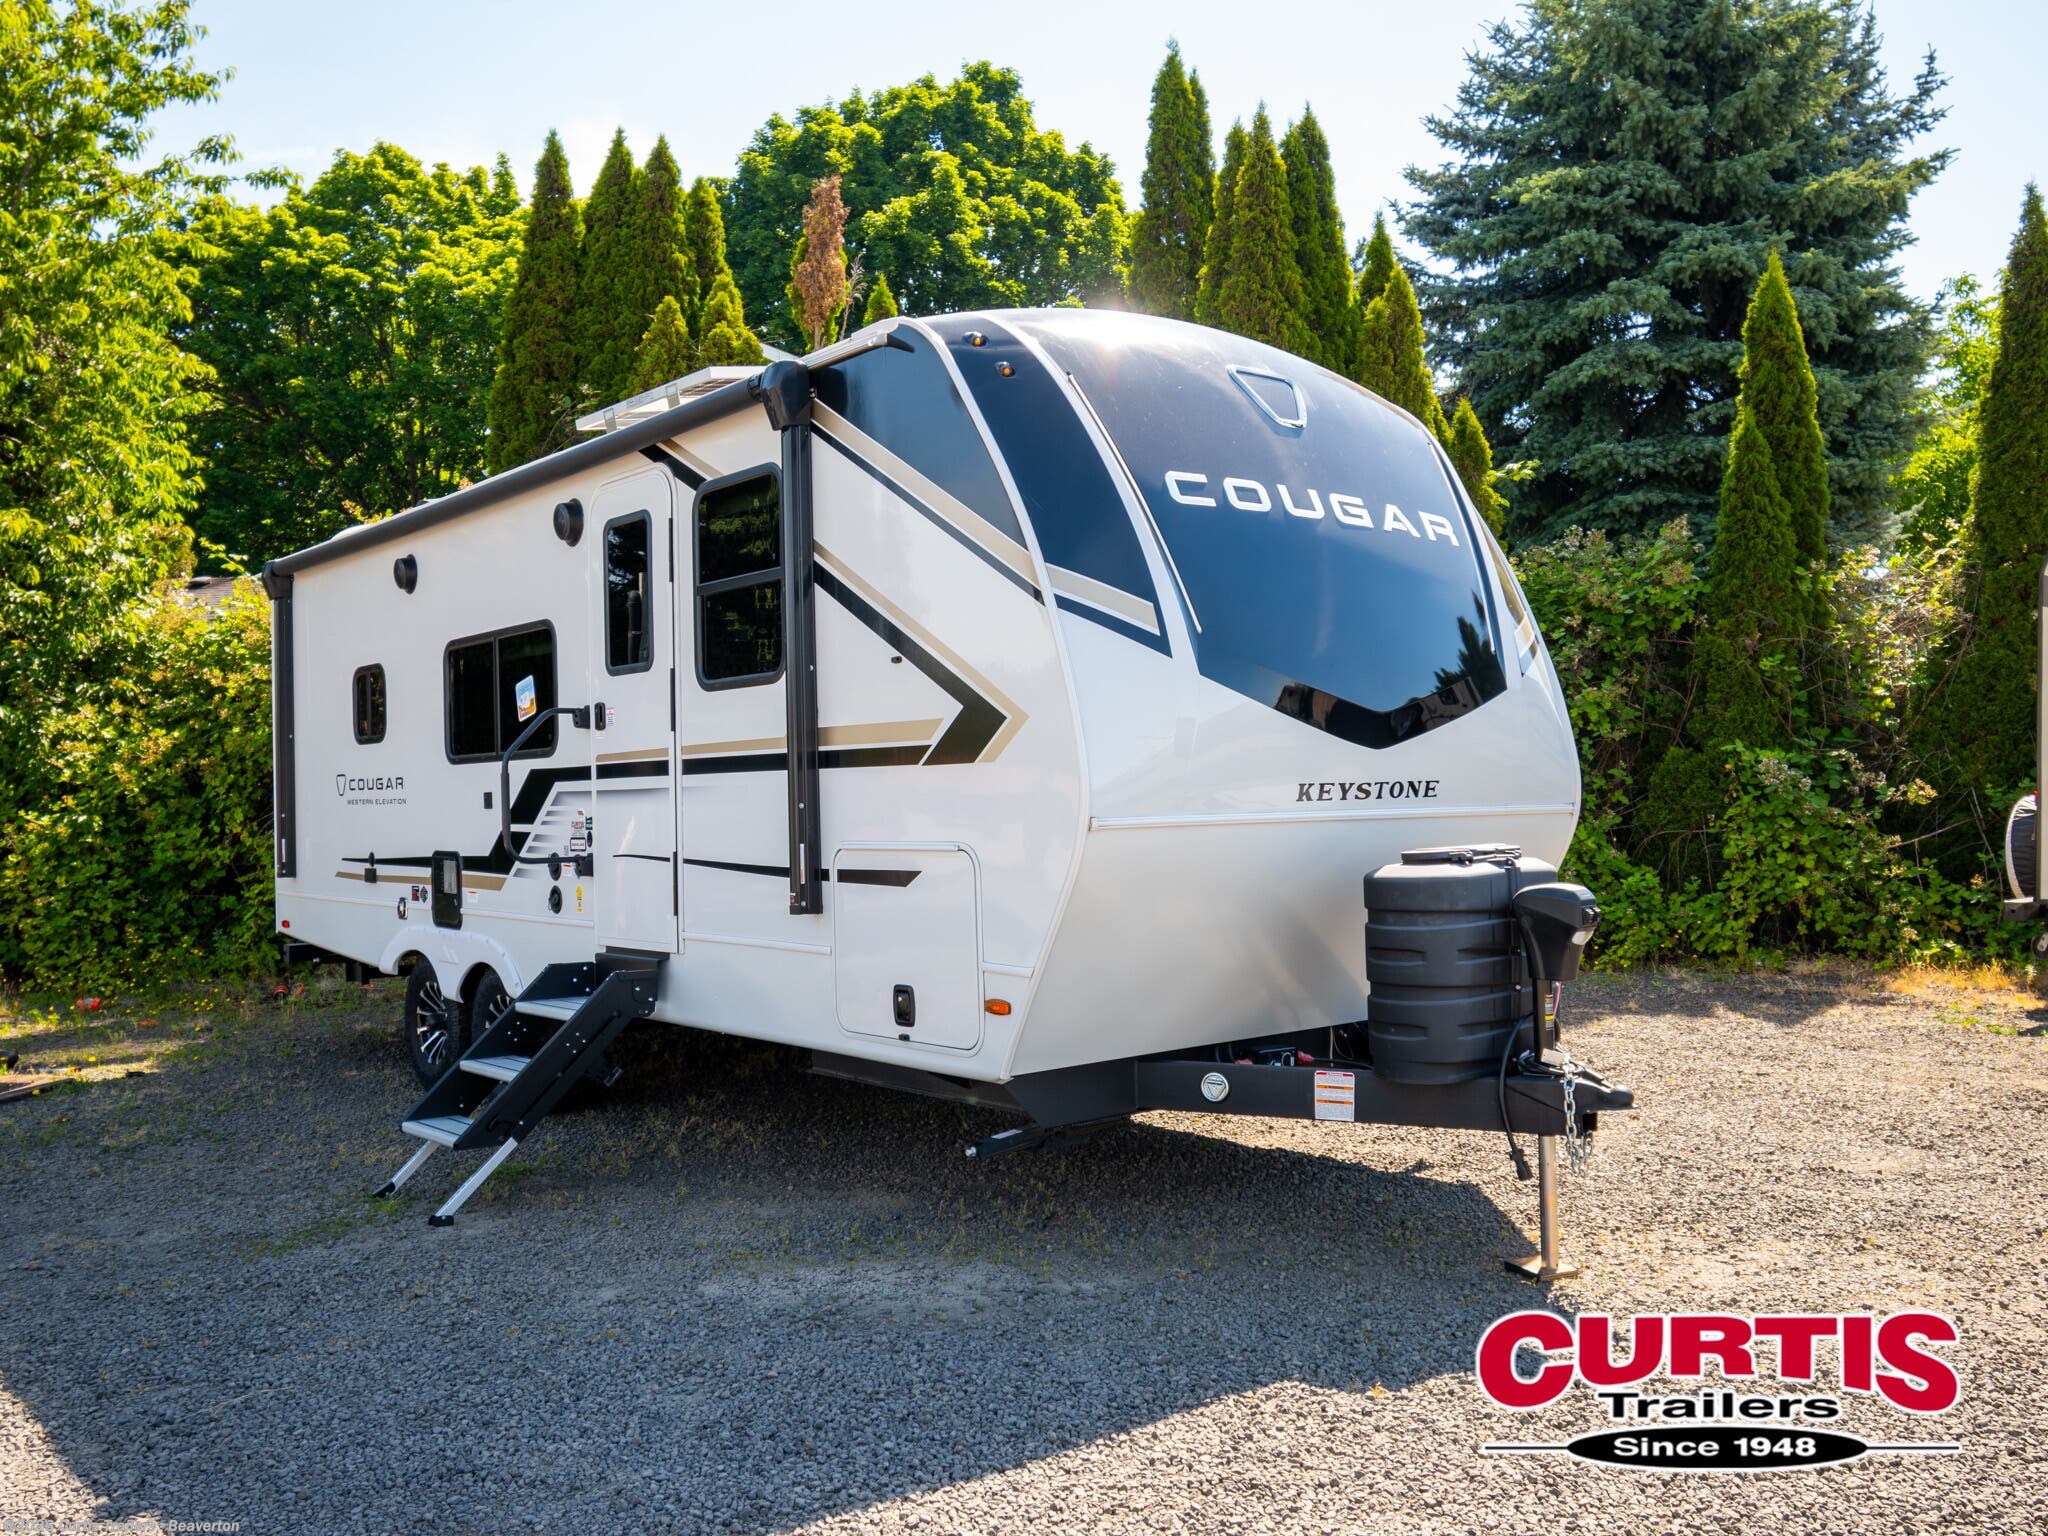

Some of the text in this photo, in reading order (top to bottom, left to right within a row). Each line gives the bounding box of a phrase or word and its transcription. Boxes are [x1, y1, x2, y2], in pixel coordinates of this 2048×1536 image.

[1164, 470, 1460, 547] COUGAR
[348, 776, 404, 791] COUGAR
[1295, 780, 1440, 802] KEYSTONE
